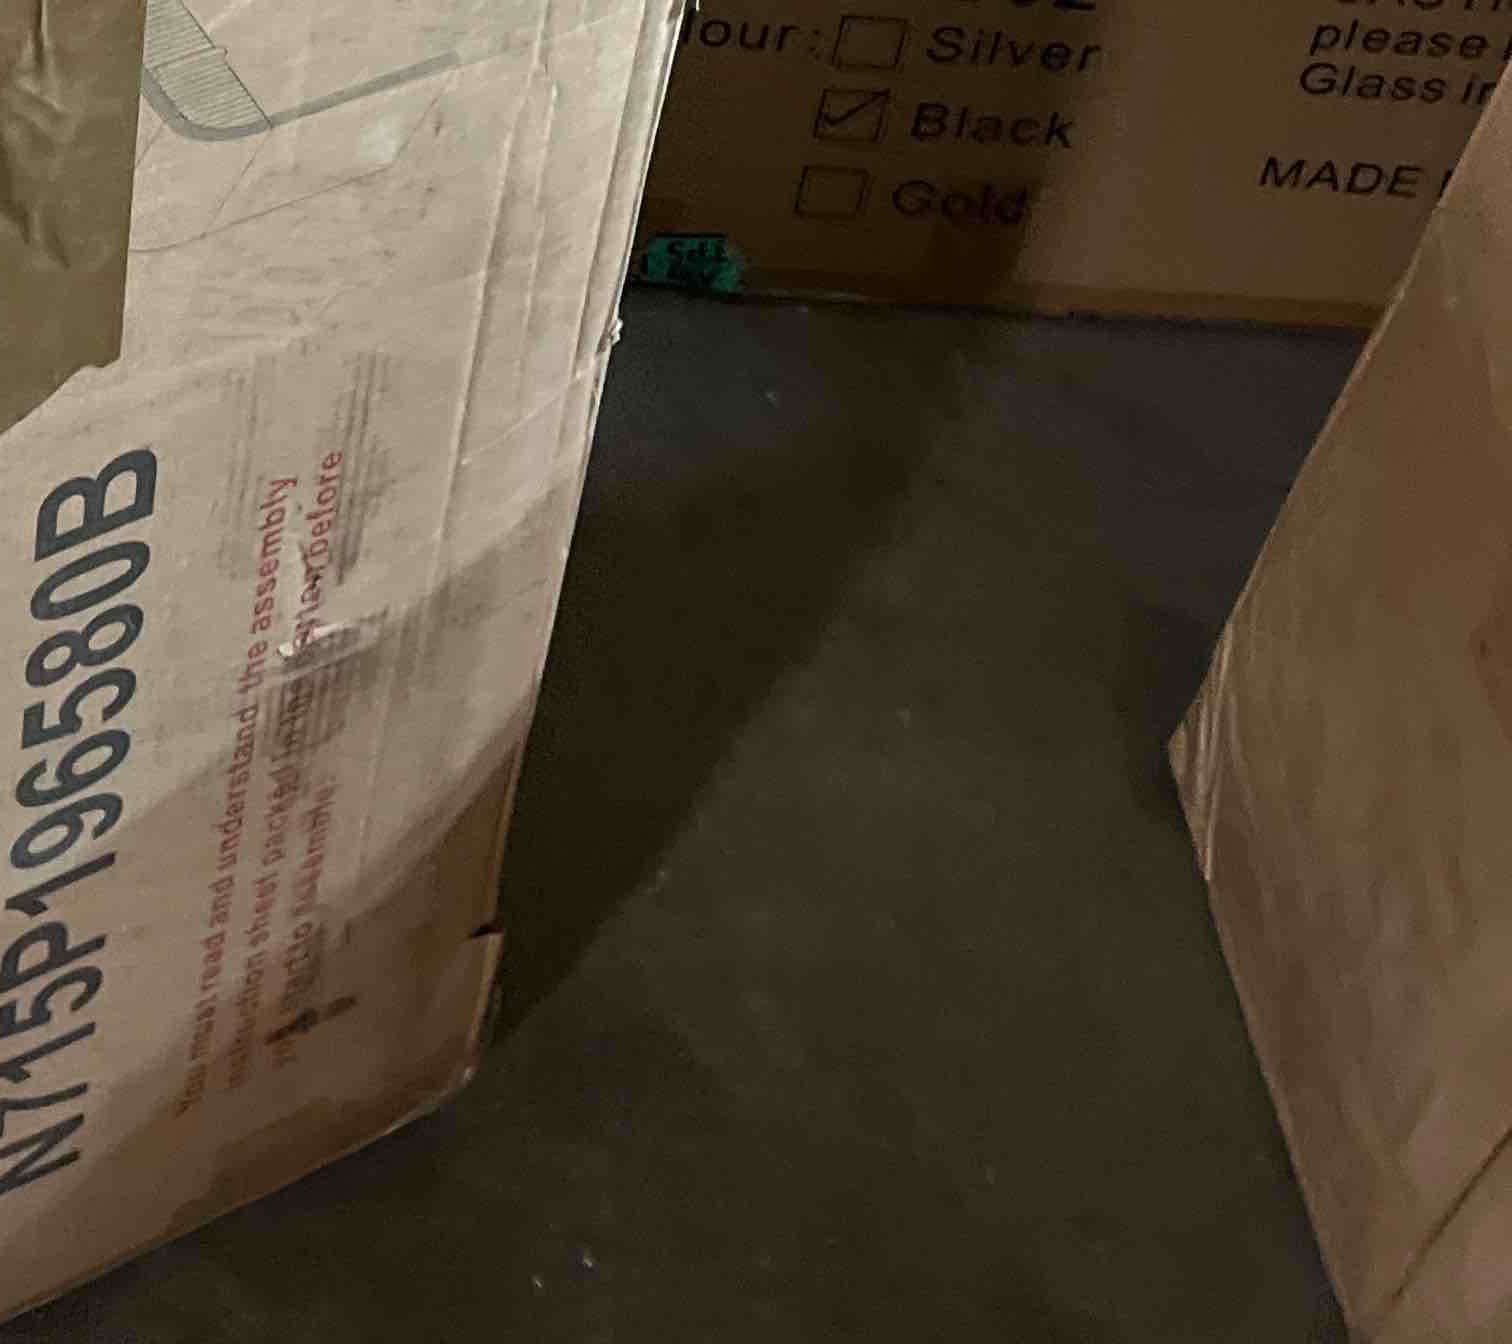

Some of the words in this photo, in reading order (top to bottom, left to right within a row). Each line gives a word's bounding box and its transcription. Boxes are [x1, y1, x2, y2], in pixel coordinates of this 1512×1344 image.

[679, 10, 823, 60] lour:
[925, 25, 1103, 73] Silver
[1308, 17, 1489, 60] please
[1299, 61, 1447, 104] Glass
[910, 101, 1075, 149] Black
[891, 179, 1031, 227] Gold
[1257, 155, 1422, 199] MADE
[305, 450, 344, 566] before
[246, 474, 298, 636] assembly
[238, 639, 268, 694] the
[213, 703, 257, 873] understand
[207, 875, 233, 930] and
[198, 930, 226, 993] read
